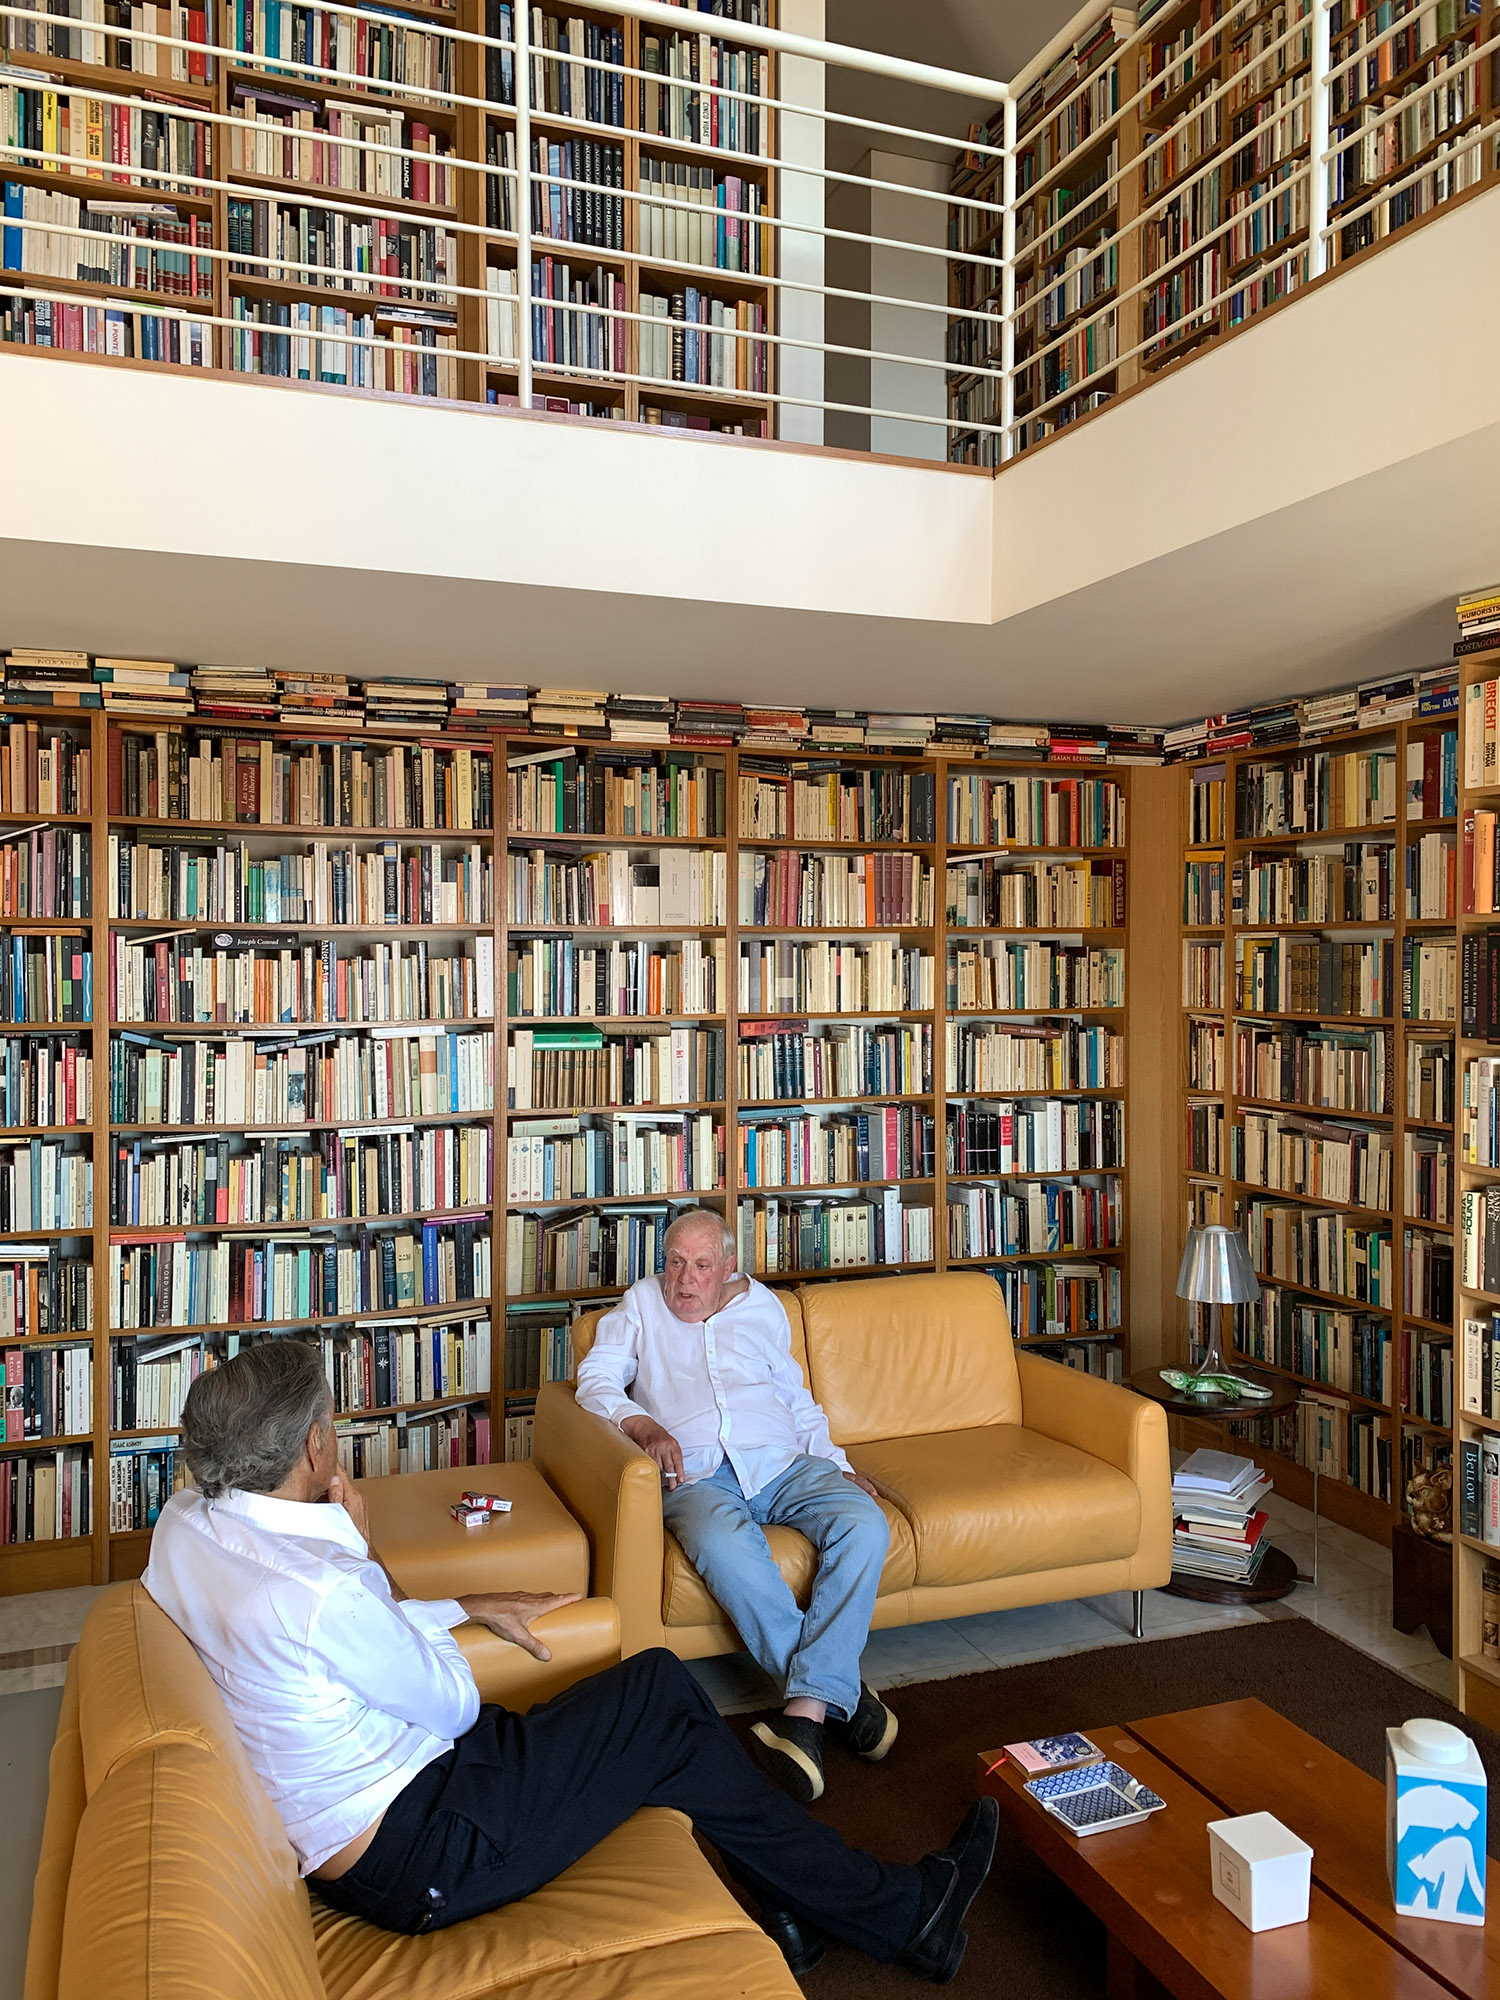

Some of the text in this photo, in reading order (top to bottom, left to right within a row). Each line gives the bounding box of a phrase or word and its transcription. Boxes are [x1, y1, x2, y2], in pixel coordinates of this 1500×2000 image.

[1485, 681, 1496, 730] BRECHT
[414, 758, 422, 786] Sillitoe
[248, 802, 256, 811] de
[386, 865, 394, 906] TRUMAN CAPOTE
[237, 938, 256, 946] Joseph
[1402, 969, 1411, 1004] VATICANO
